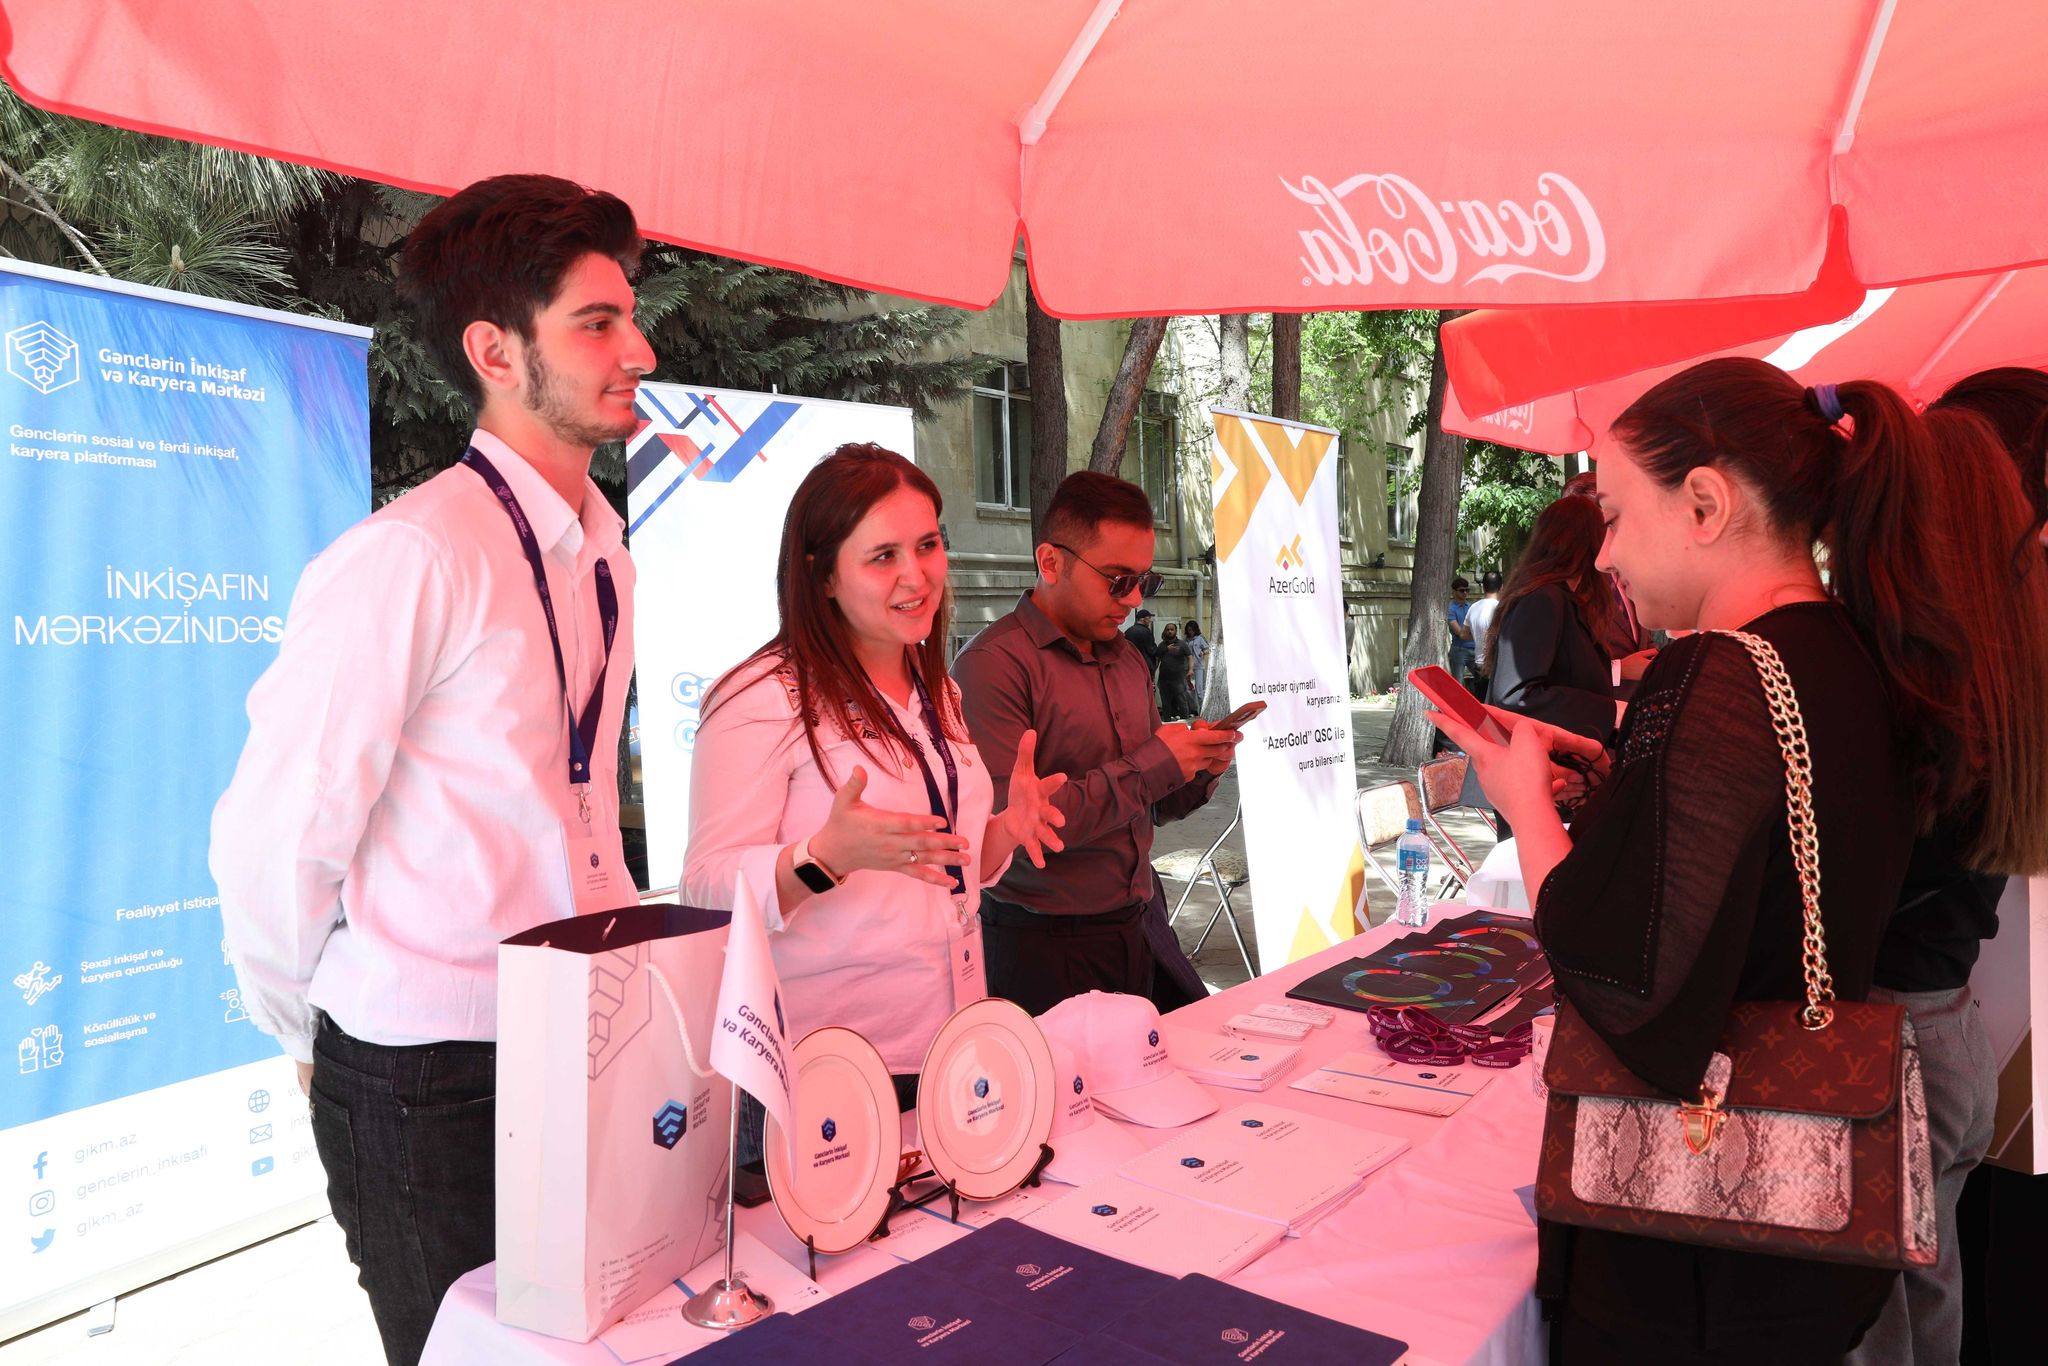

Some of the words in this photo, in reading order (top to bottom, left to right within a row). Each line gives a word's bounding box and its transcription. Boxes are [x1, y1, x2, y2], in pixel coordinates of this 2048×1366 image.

[99, 348, 185, 374] Gənclərin
[190, 358, 247, 382] İnkişaf
[102, 368, 121, 383] və
[128, 369, 196, 393] Karyera
[201, 381, 265, 402] Mərkəzi
[10, 424, 88, 445] Gənclərin
[91, 434, 134, 450] sosial
[137, 440, 155, 452] və
[159, 438, 190, 454] fərdi
[193, 442, 240, 461] inkişaf,
[10, 443, 70, 463] karyera
[74, 448, 157, 468] platforması
[107, 564, 269, 607] İNKİŞAFIN
[1269, 576, 1315, 595] AzerGold
[1267, 681, 1288, 696] qədər
[1289, 679, 1316, 695] qiymətli
[1314, 727, 1333, 744] QSC
[1334, 726, 1345, 740] ilə
[1298, 758, 1314, 773] qura
[116, 901, 181, 922] Fəaliyyət
[80, 957, 111, 974] Şəxsi
[113, 951, 149, 968] inkişaf
[151, 948, 164, 959] və
[81, 968, 123, 985] karyera
[124, 957, 183, 978] quruculuğu
[83, 1015, 141, 1035] Könüllülük
[143, 1011, 156, 1023] və
[84, 1026, 148, 1049] sosiallaşma
[723, 1017, 738, 1033] və
[738, 1027, 779, 1073] Karyera
[74, 1133, 137, 1163] gikm.az
[76, 1144, 208, 1200] genclerin_inkisafi
[76, 1201, 144, 1237] gikm_az
